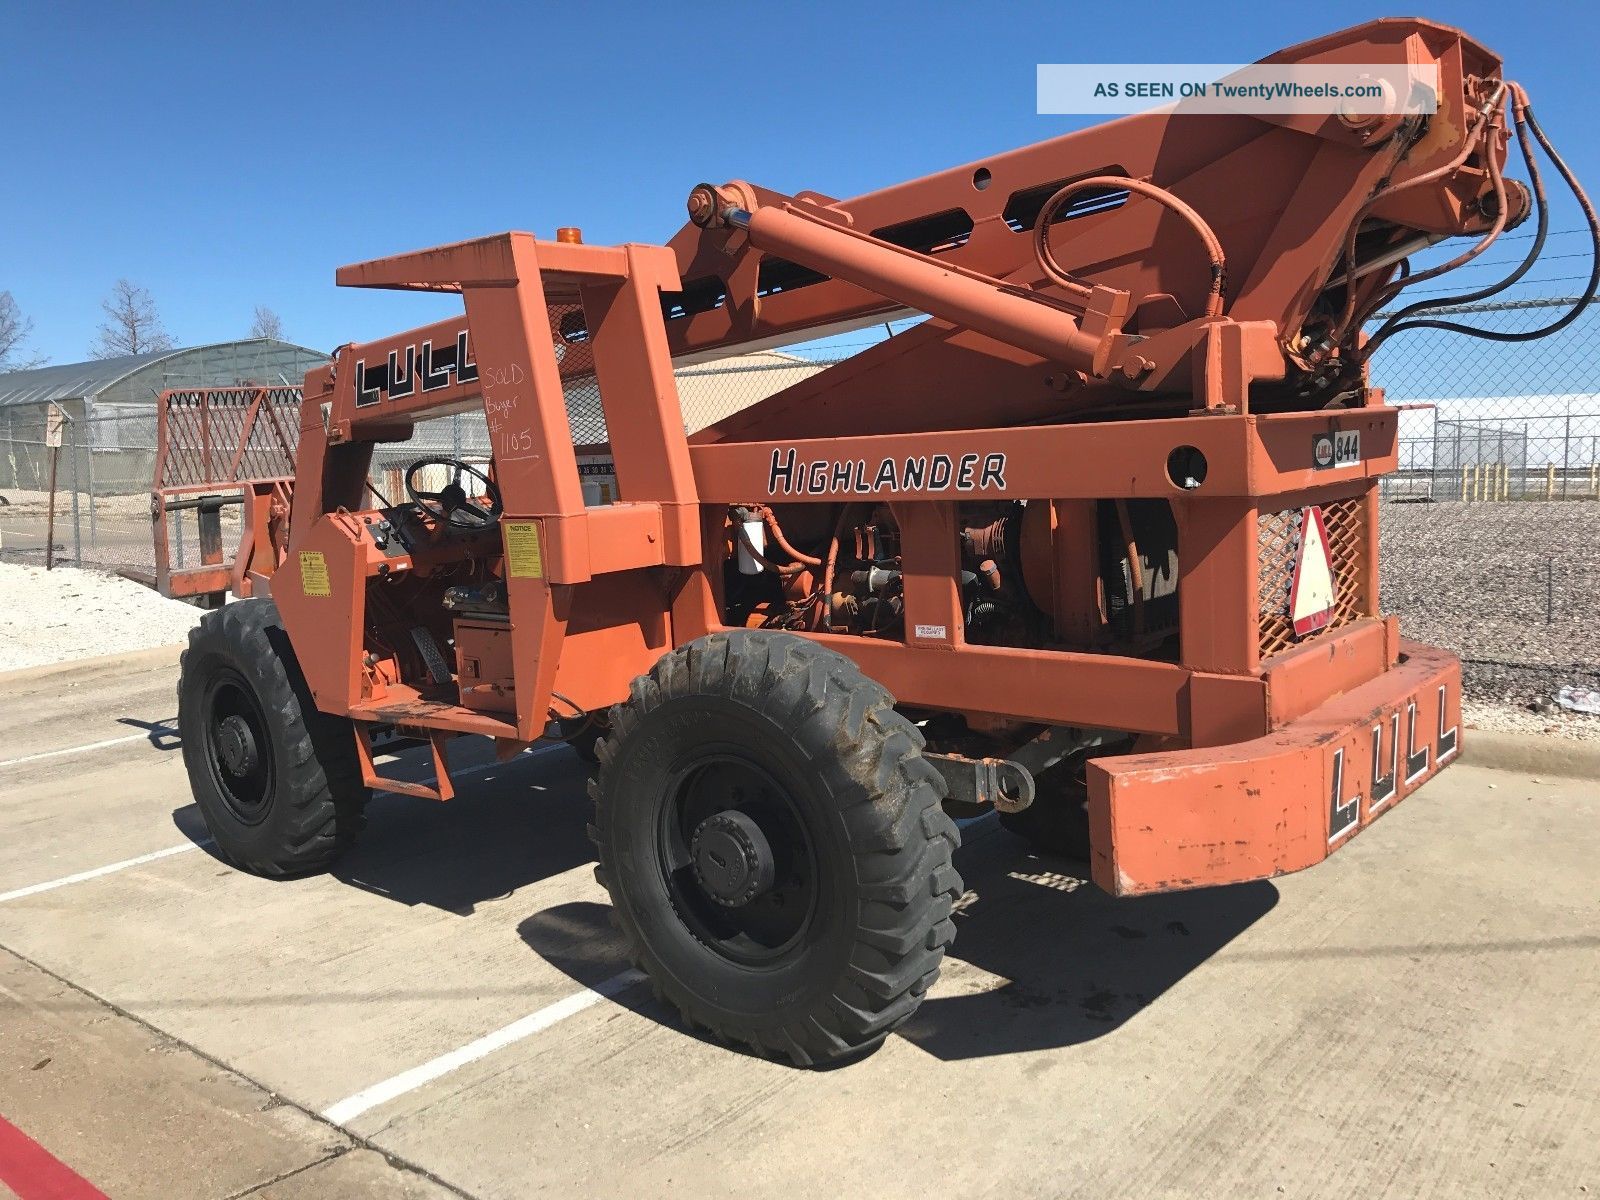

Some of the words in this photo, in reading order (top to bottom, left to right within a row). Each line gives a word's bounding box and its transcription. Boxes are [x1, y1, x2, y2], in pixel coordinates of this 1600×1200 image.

[356, 330, 479, 408] LULL
[484, 363, 525, 389] SOLD
[485, 395, 519, 419] Buyer
[501, 427, 532, 455] 1105
[1336, 434, 1358, 462] 844
[767, 447, 1007, 496] HIGHLANDER
[1328, 685, 1458, 844] LULL
